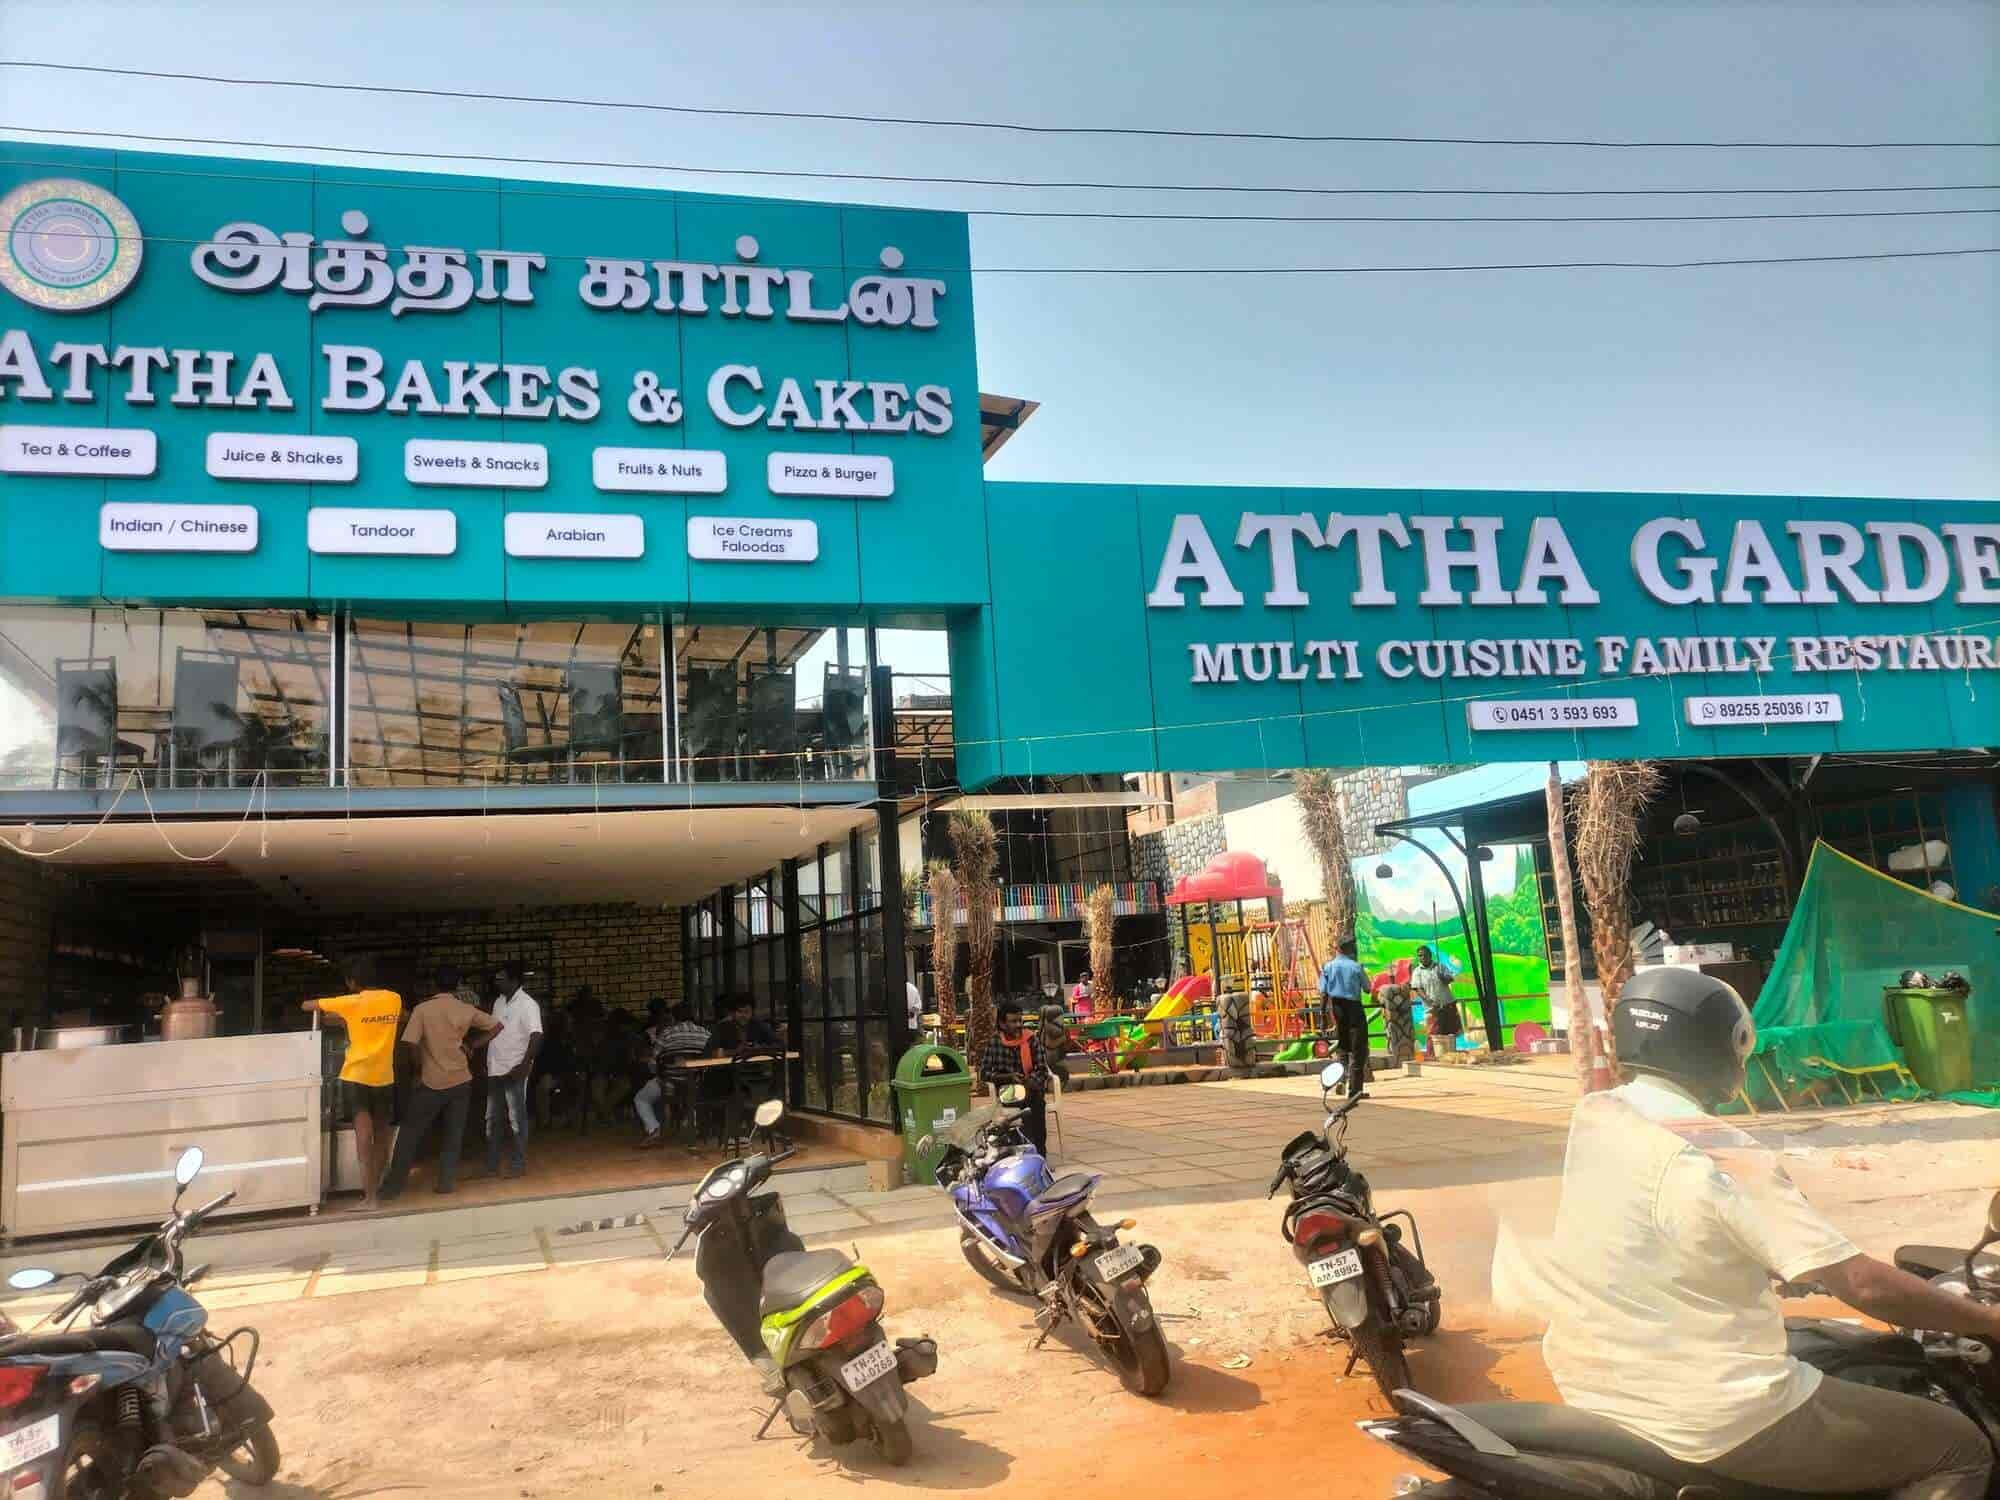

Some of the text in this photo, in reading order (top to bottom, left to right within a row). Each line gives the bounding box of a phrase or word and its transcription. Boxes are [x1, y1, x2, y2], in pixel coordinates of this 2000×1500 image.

[192, 211, 945, 326] அத்தா கார்டன்
[0, 330, 952, 433] ATTHA BAKES & CAKES
[22, 443, 131, 457] Tea & Coffee
[222, 448, 343, 464] Juice & Shakes
[414, 455, 539, 471] Sweets & Snacks
[619, 463, 702, 476] Fruits & Nuts
[785, 466, 877, 482] Pizza & Burger
[110, 519, 248, 533] Indian / Chinese
[351, 524, 415, 536] Tandoor
[713, 525, 792, 537] Ice Creams
[546, 529, 605, 541] Arabian
[722, 540, 784, 552] Faloodas
[1148, 512, 2000, 606] ATTHA GARDE
[1189, 640, 1362, 681] MULTI
[1377, 640, 1585, 677] CUISINE
[1597, 637, 1776, 676] FAMILY
[1511, 706, 1617, 721] 0451 3 593 693
[1720, 703, 1760, 717] 89255
[1764, 702, 1803, 716] 25036
[1815, 701, 1829, 714] 37
